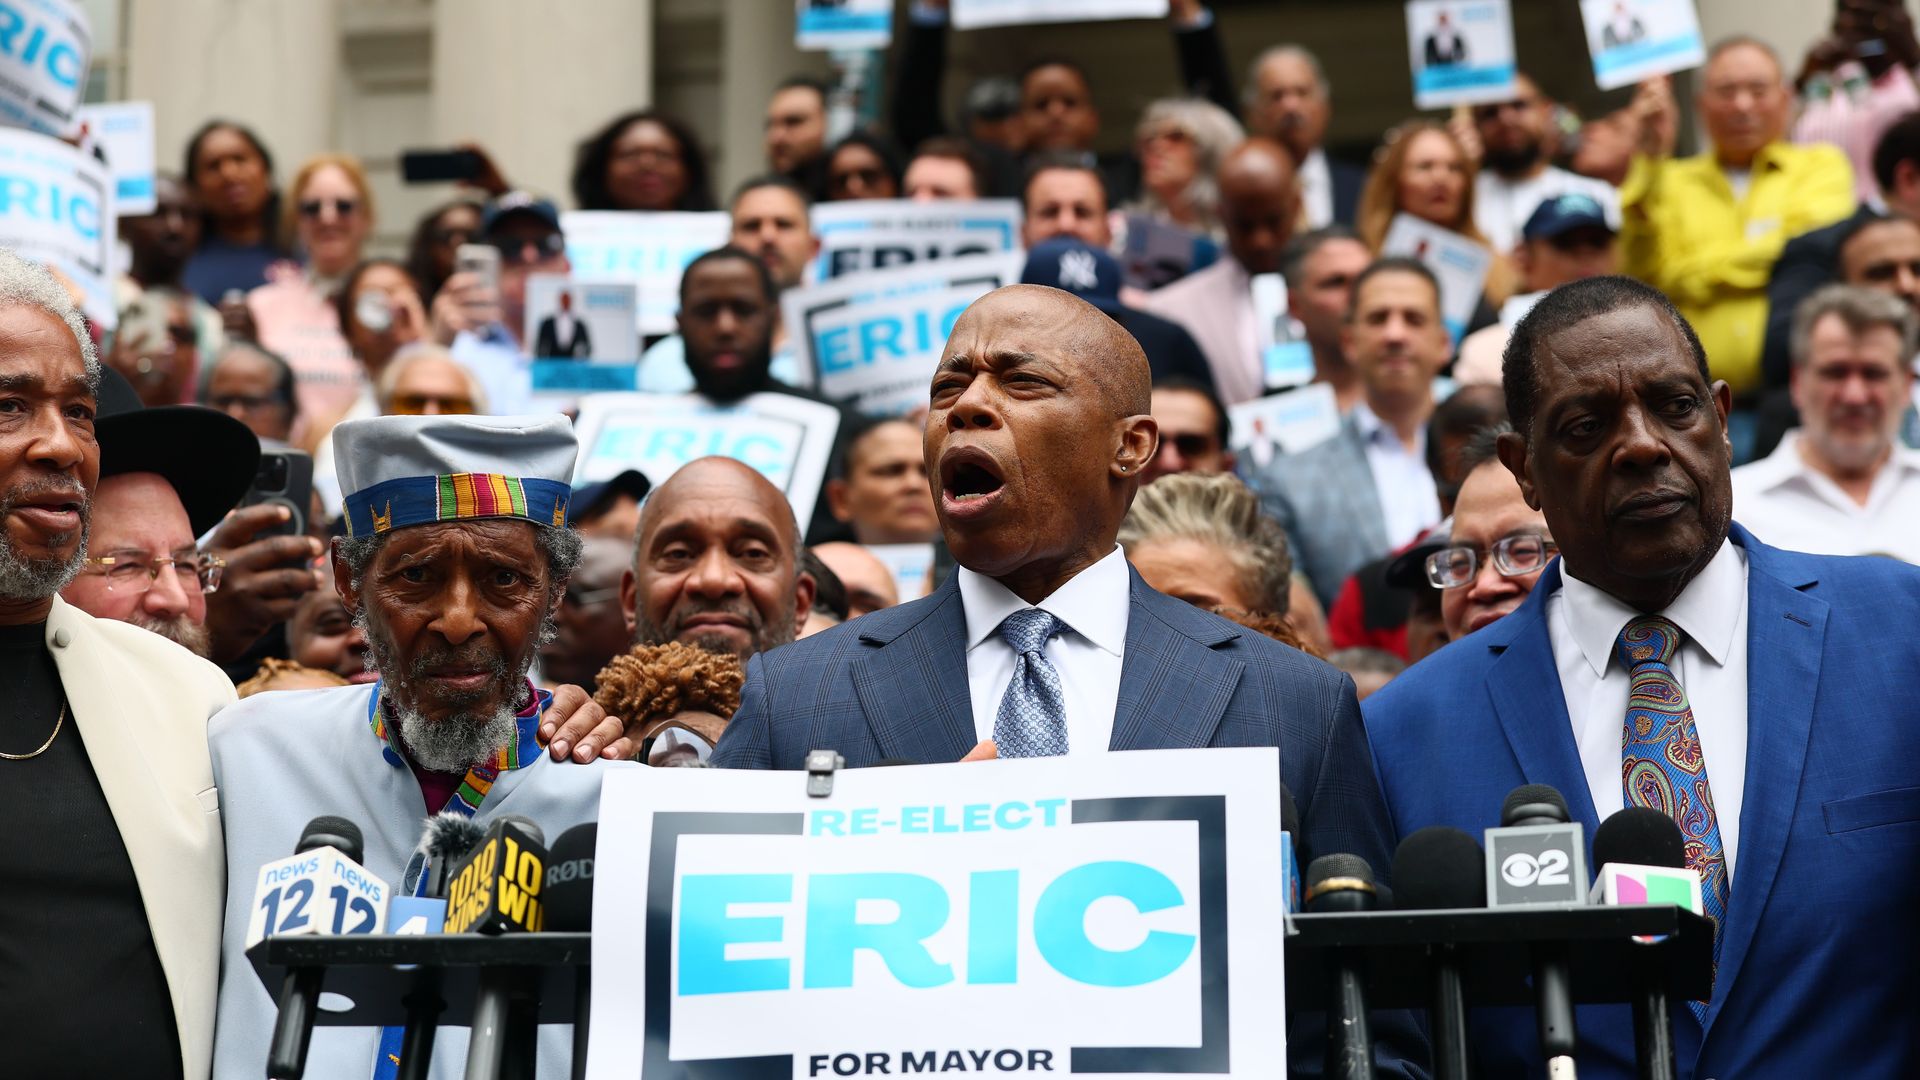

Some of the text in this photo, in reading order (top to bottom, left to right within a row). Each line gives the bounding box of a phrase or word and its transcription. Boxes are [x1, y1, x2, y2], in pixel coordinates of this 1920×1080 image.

[809, 798, 1067, 837] RE-ELECT
[265, 858, 319, 885] news
[334, 860, 381, 902] news
[448, 838, 498, 917] 1010
[546, 858, 595, 887] RØD
[260, 878, 314, 939] 12
[329, 885, 377, 935] 12
[678, 860, 1197, 995] ERIC
[809, 1049, 1054, 1077] FOR MAYOR
